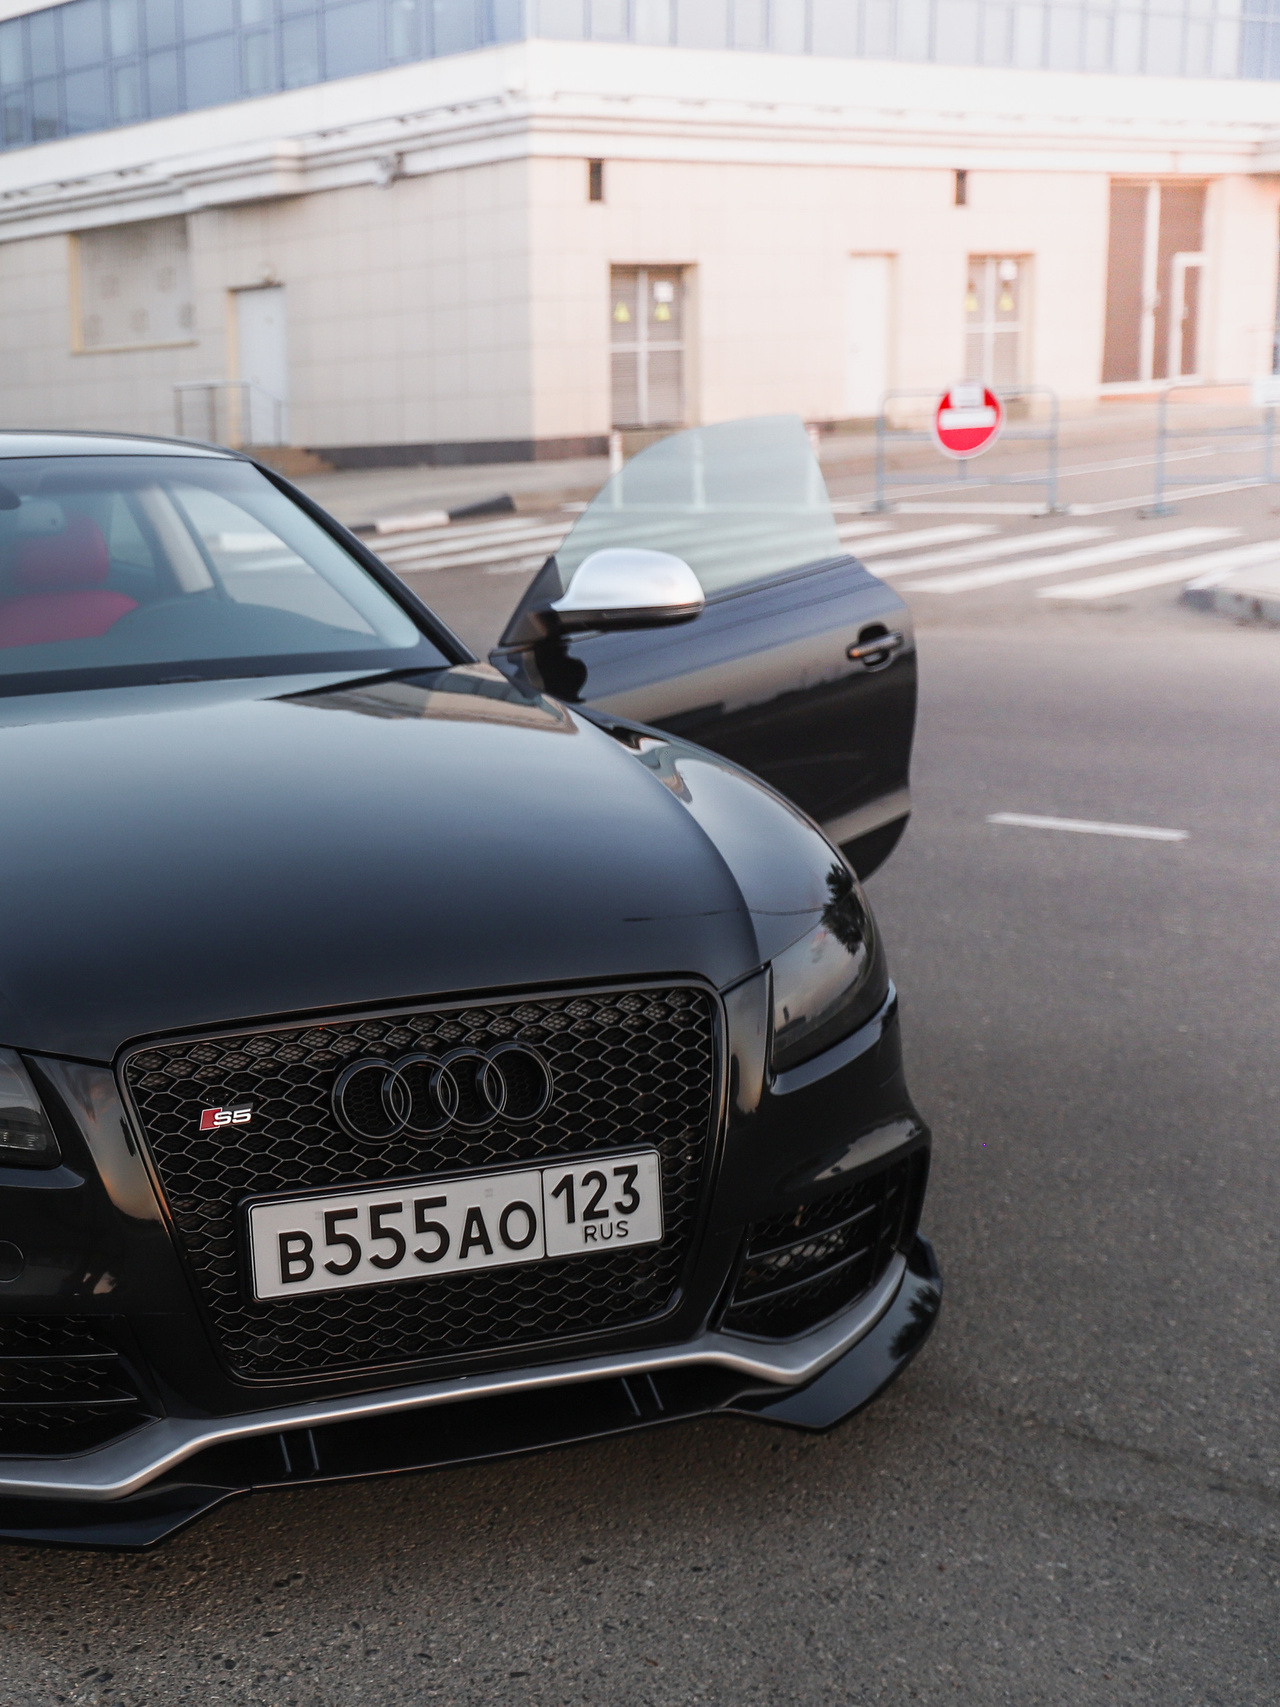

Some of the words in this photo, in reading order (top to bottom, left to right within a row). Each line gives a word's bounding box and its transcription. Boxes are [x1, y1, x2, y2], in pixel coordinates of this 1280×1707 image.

[213, 1108, 252, 1126] S5
[550, 1164, 640, 1224] 123
[583, 1220, 629, 1243] RUS
